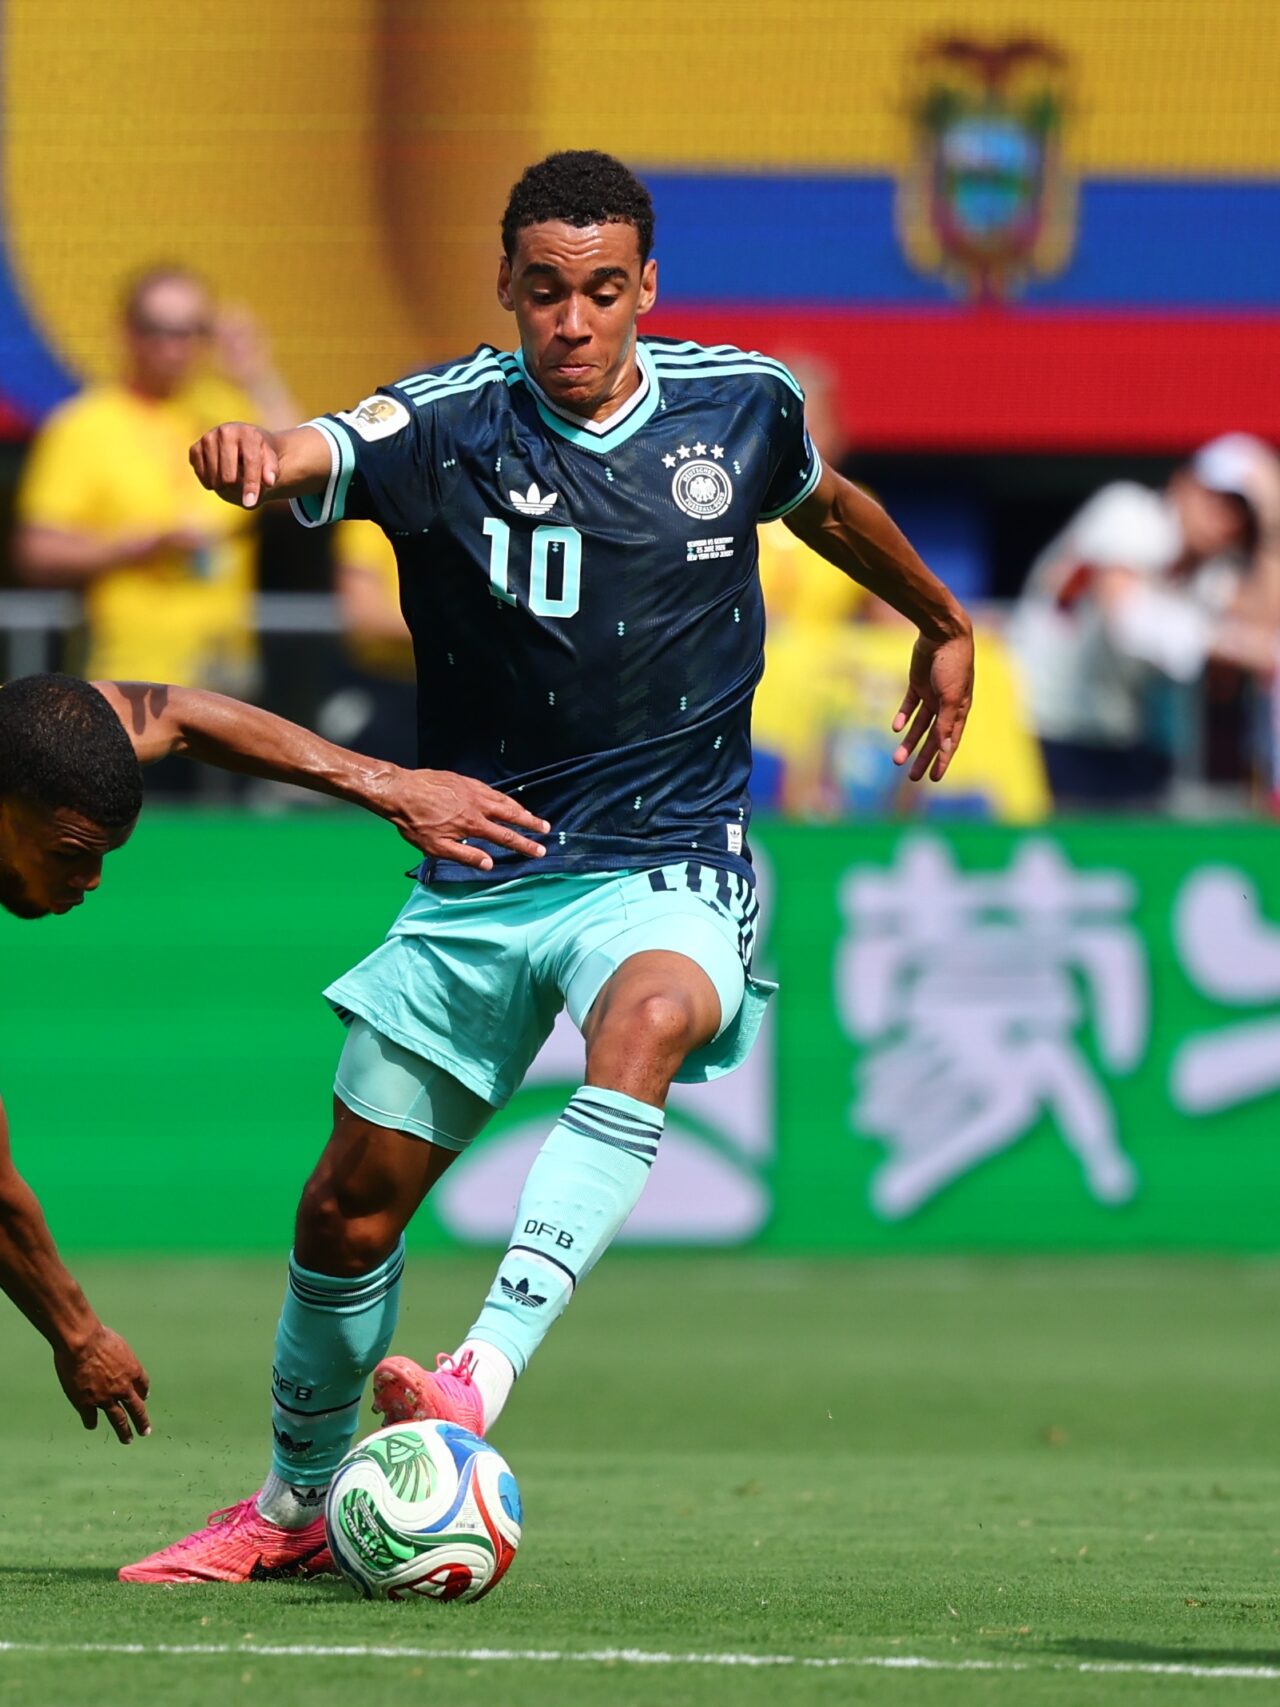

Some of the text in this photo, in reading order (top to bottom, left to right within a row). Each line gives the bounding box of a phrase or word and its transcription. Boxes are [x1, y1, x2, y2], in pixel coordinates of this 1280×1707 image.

[482, 517, 582, 618] 10
[523, 1219, 574, 1250] DFB
[272, 1365, 313, 1400] DFB
